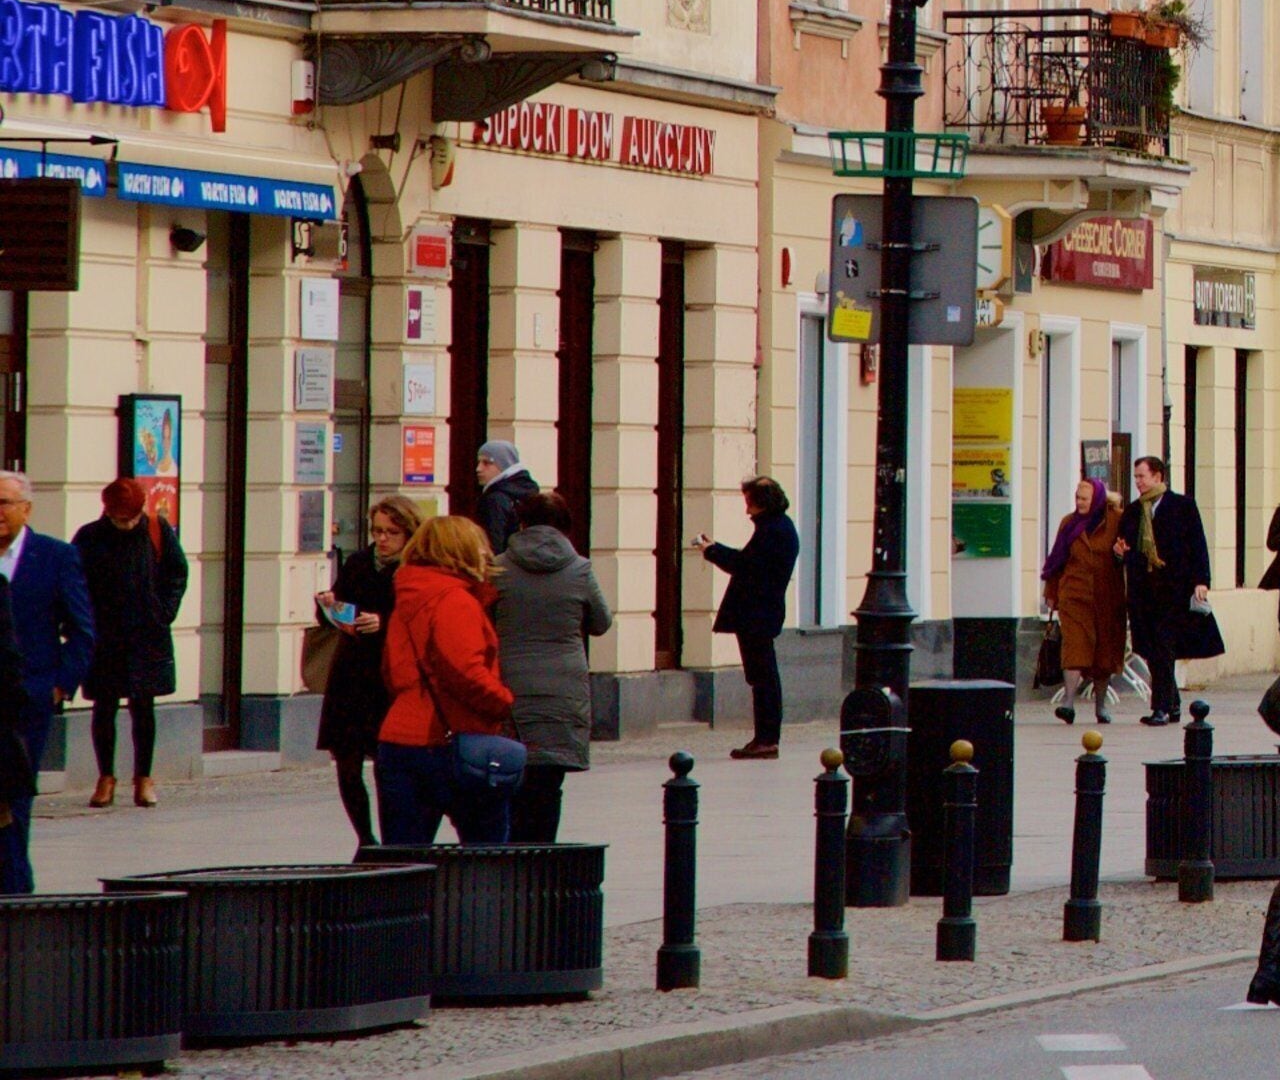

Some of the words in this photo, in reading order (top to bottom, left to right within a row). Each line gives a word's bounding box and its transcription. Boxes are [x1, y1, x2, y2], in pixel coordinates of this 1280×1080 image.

[77, 12, 166, 108] FISH
[576, 108, 614, 161] DOM
[629, 116, 717, 174] AUKCYJNY
[1114, 219, 1146, 260] CORNER
